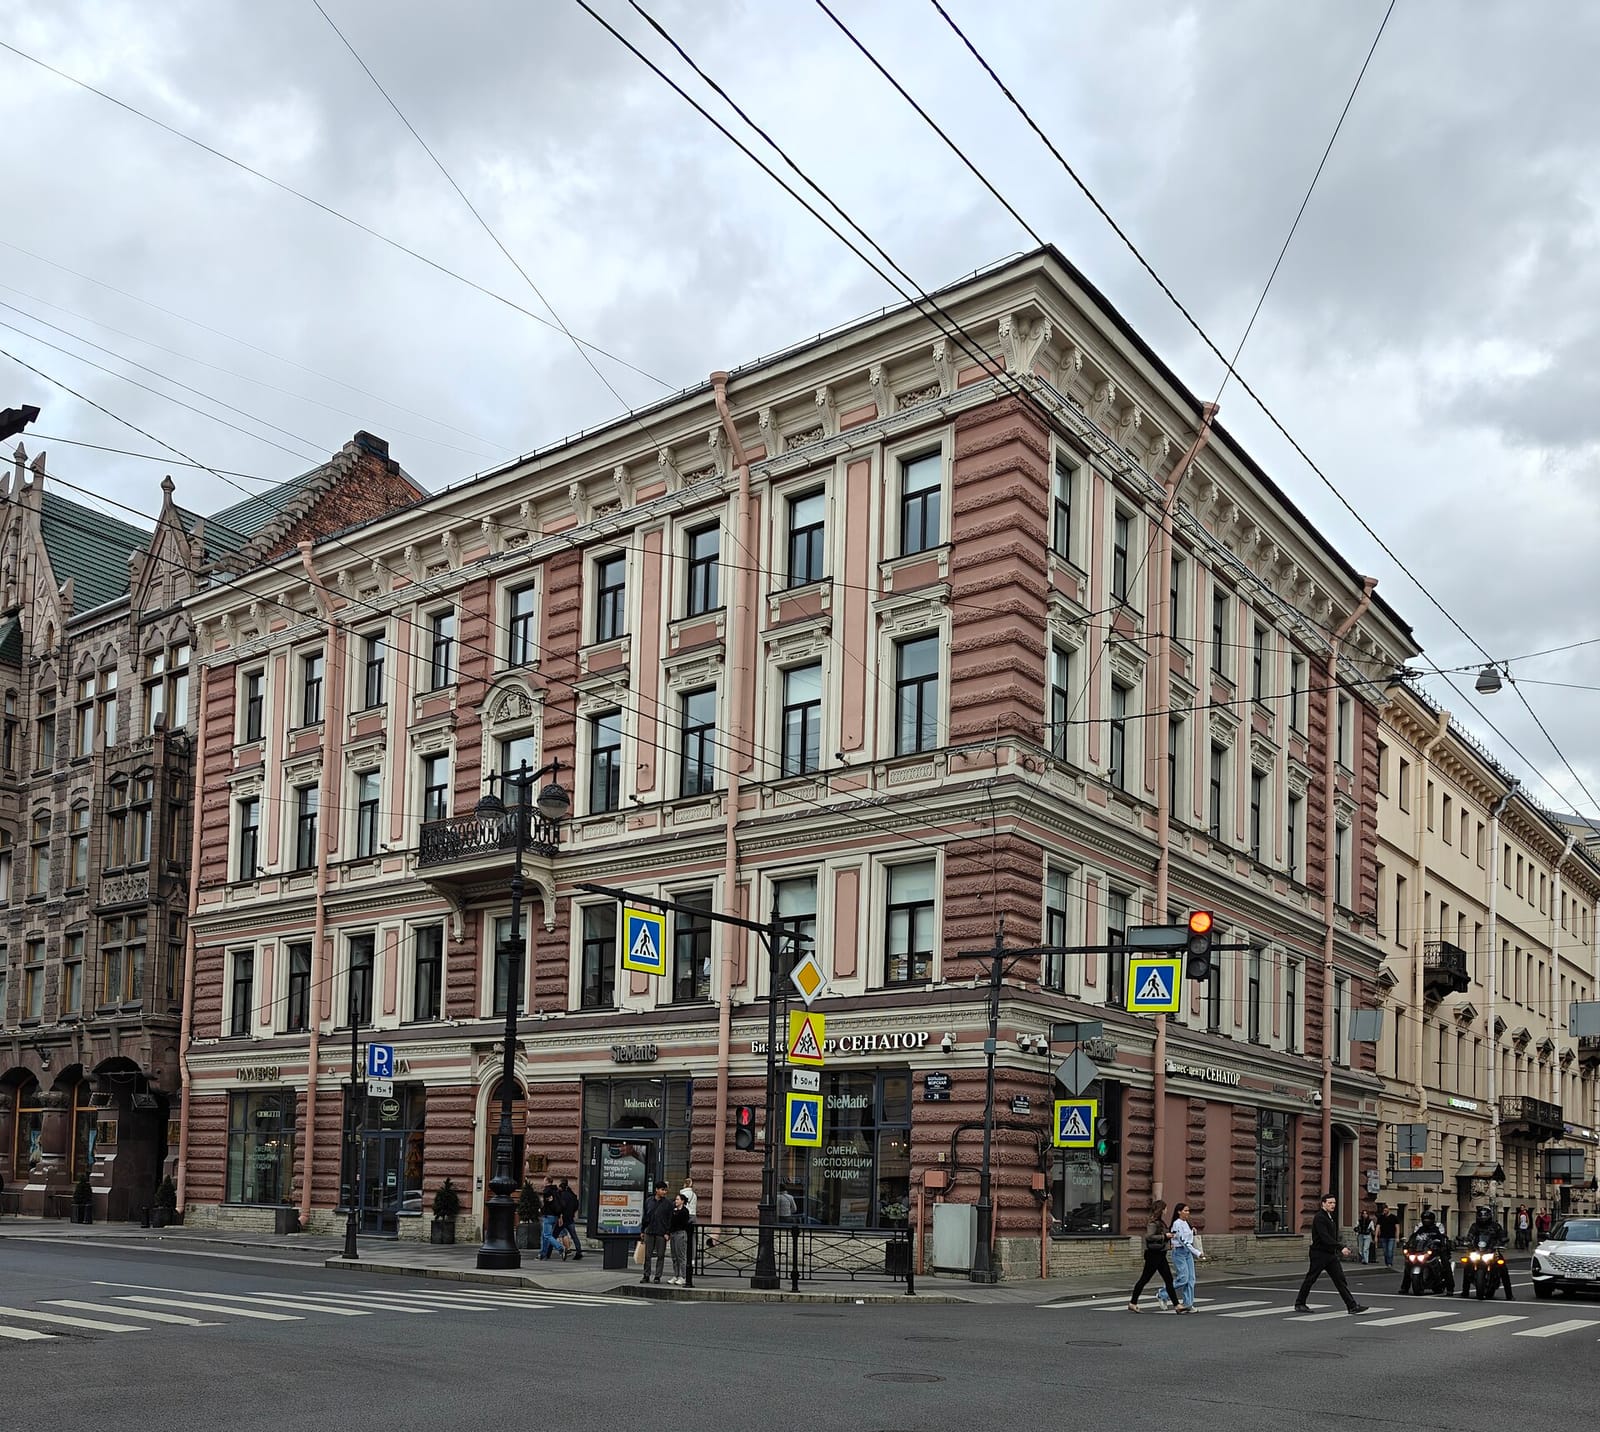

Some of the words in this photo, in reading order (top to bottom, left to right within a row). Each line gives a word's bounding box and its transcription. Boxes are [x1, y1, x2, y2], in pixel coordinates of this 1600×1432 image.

[839, 1031, 929, 1051] СЕНАТОР
[374, 1047, 388, 1073] P
[1206, 1066, 1241, 1086] СЕНАТОР
[827, 1095, 868, 1109] SieMatic
[826, 1145, 858, 1155] СМЕНА
[812, 1157, 873, 1169] ЭКСПОЗИЦИИ
[824, 1169, 860, 1180] СКИДКИ
